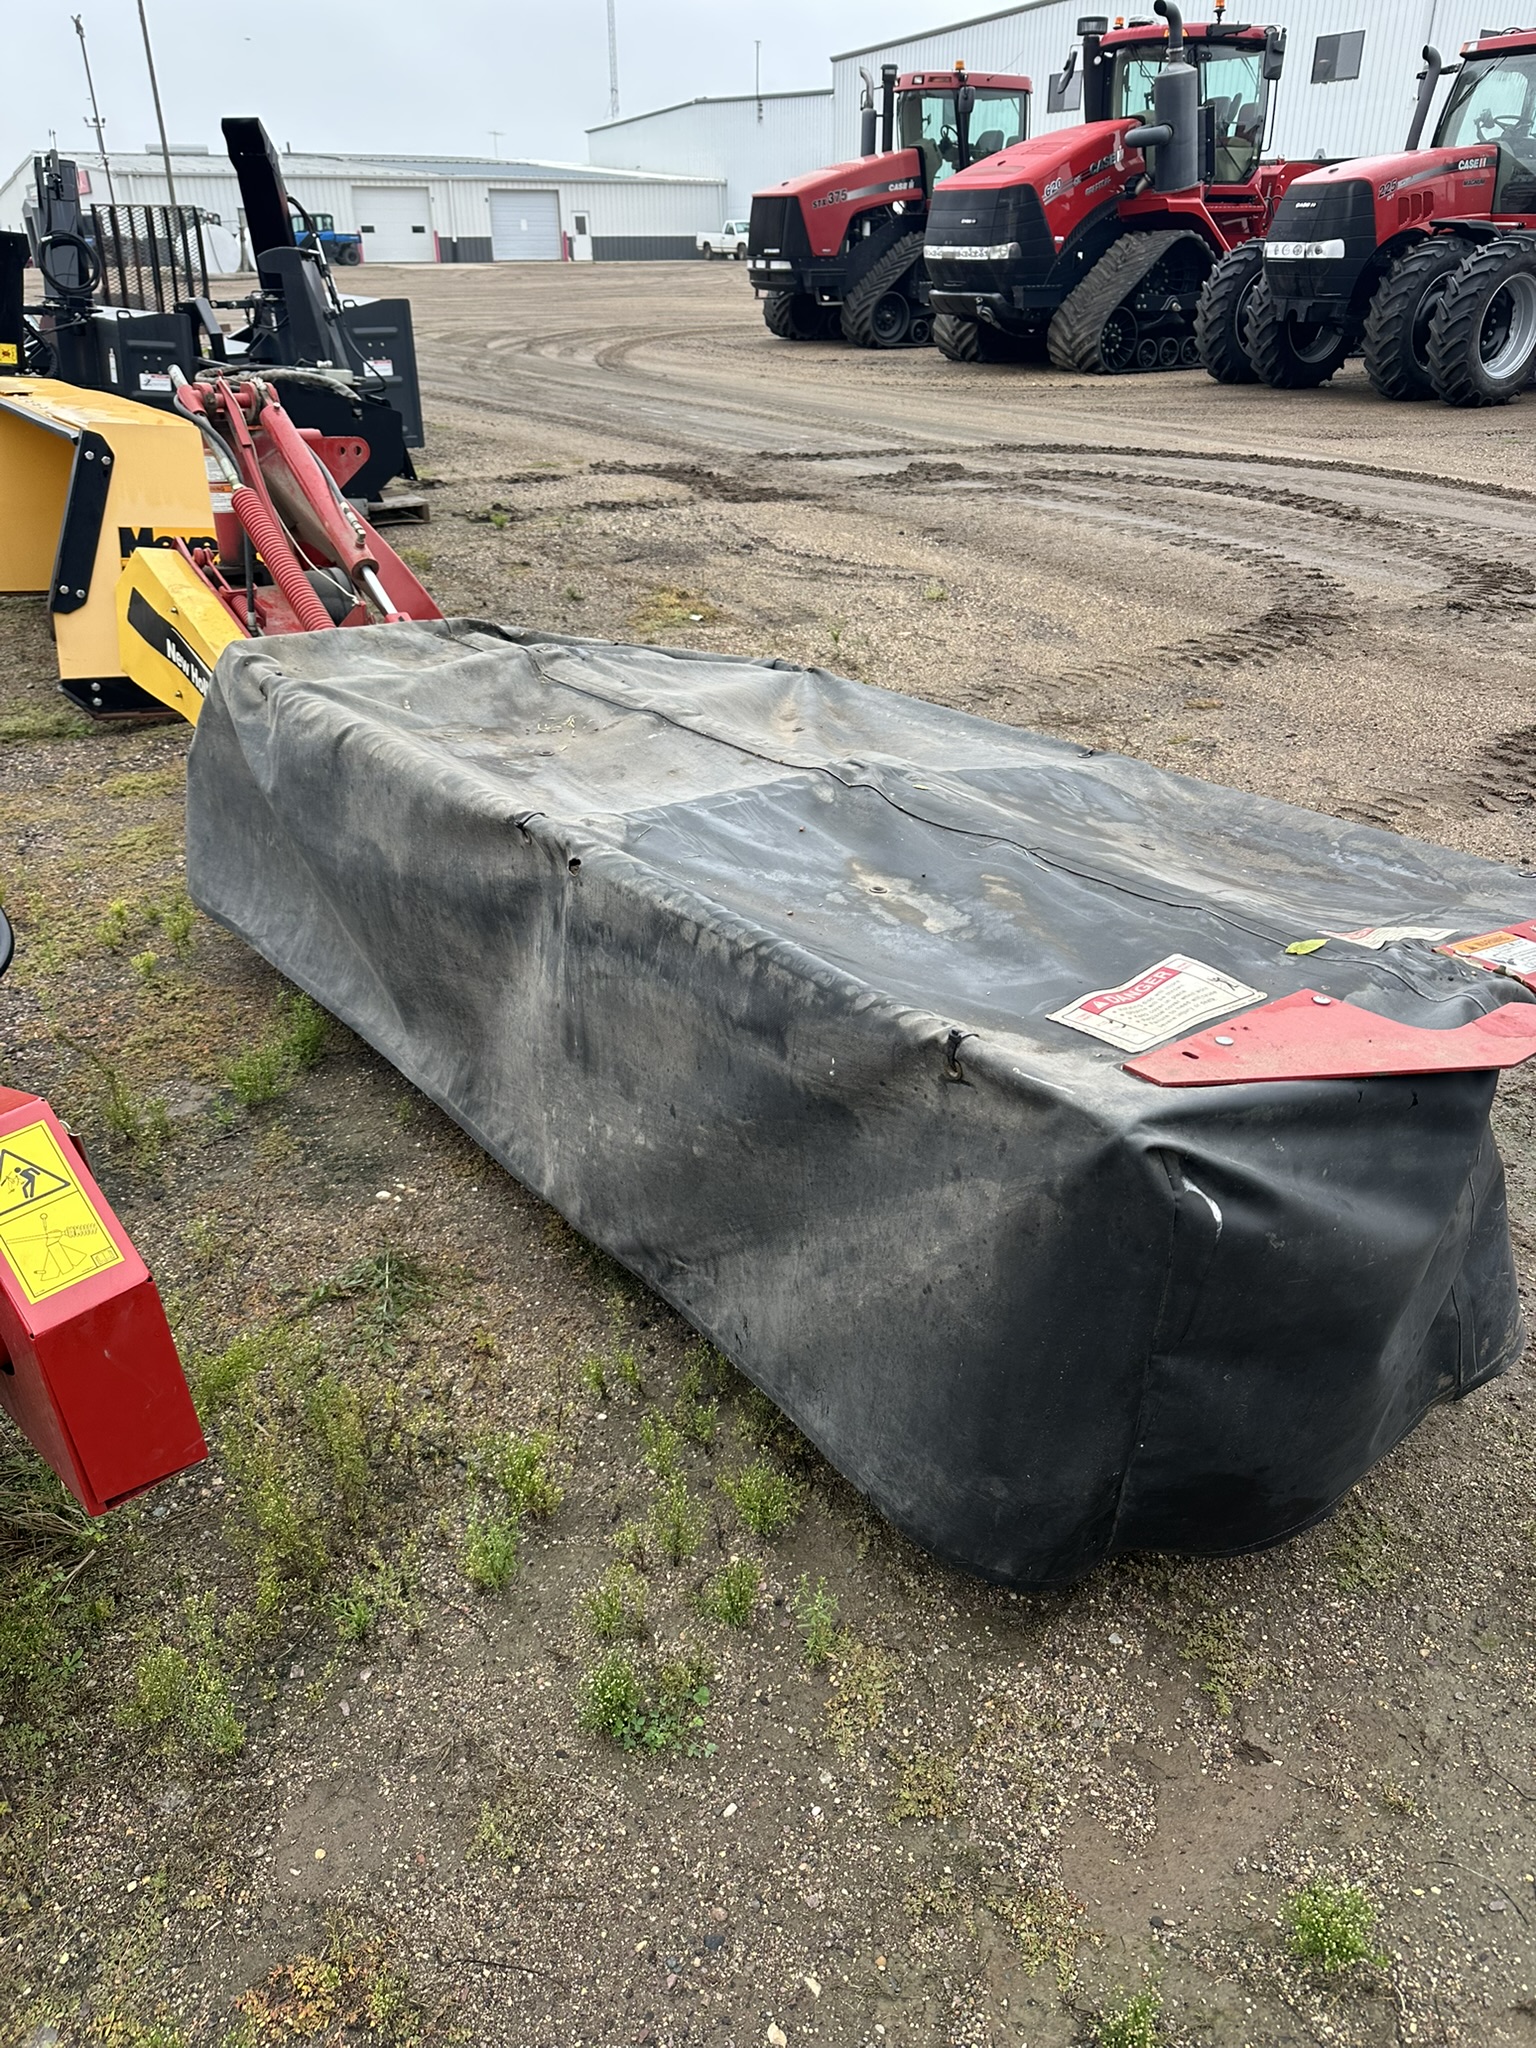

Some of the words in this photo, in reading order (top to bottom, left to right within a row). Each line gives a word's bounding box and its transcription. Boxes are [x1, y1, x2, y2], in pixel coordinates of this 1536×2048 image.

[1090, 152, 1117, 175] CASE
[1458, 158, 1480, 170] CASE
[827, 187, 849, 206] 375
[888, 182, 908, 192] CASE
[1044, 177, 1062, 198] 620
[1378, 178, 1397, 200] 225
[166, 637, 190, 677] New
[1104, 971, 1173, 1003] DANGER
